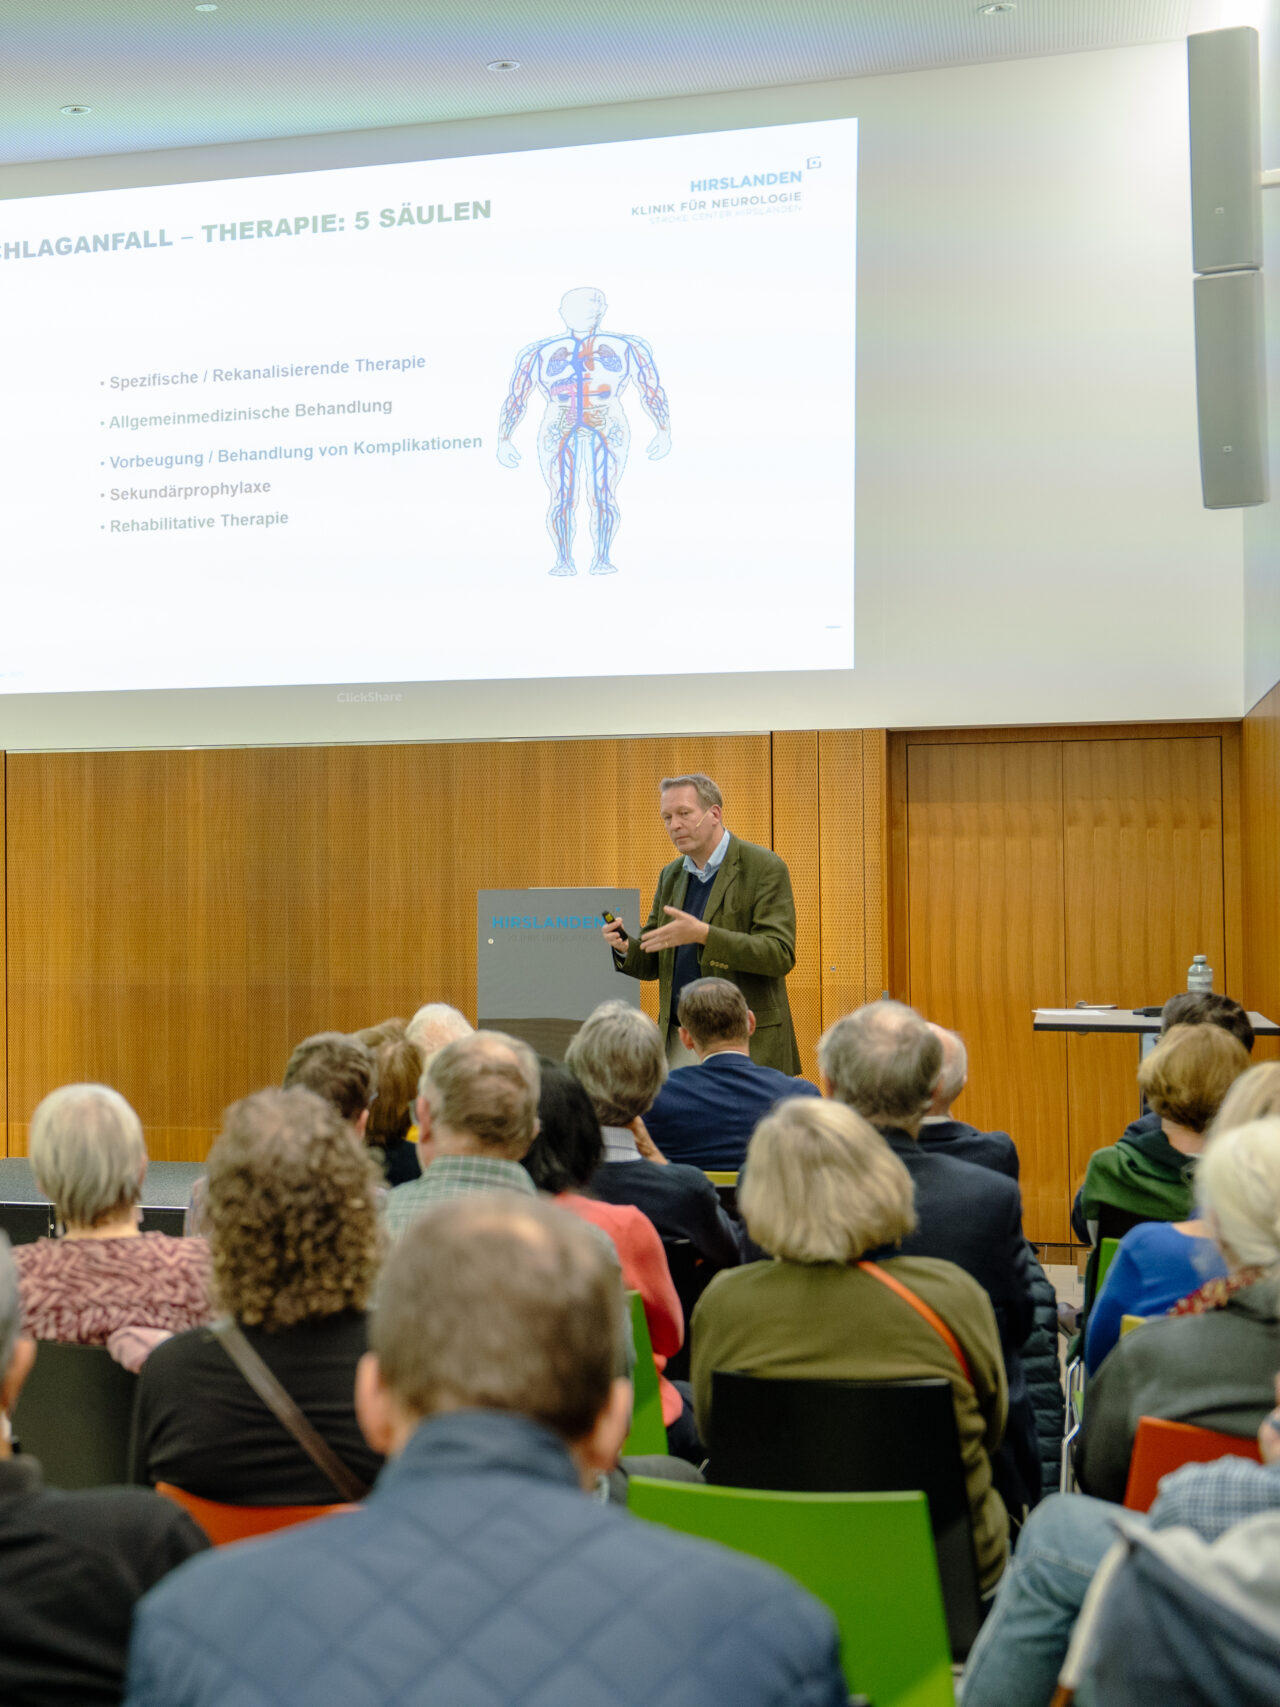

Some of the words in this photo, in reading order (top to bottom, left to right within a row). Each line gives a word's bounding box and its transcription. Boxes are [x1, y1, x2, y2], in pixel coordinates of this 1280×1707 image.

[690, 171, 803, 192] HIRSLANDEN
[631, 203, 676, 216] KLINIK
[680, 199, 707, 212] FÜR
[712, 192, 802, 209] NEUROLOGIE
[201, 213, 345, 243] THERAPIE:
[354, 210, 371, 231] 5
[379, 200, 492, 229] SÄULEN
[109, 370, 199, 391] Spezifische
[212, 361, 350, 383] Rekanalisierende
[355, 355, 426, 374] Therapie
[109, 405, 290, 430] Allgemeinmedizinische
[295, 400, 393, 418] Behandlung
[110, 450, 204, 469] Vorbeugung
[218, 445, 314, 464] Behandlung
[319, 444, 348, 458] von
[353, 434, 483, 457] Komplikationen
[110, 480, 271, 502] Sekundärprophylaxe
[110, 515, 215, 533] Rehabilitative
[220, 510, 289, 530] Therapie
[336, 691, 403, 703] ClickShare
[492, 915, 606, 929] HIRSLANDEN
